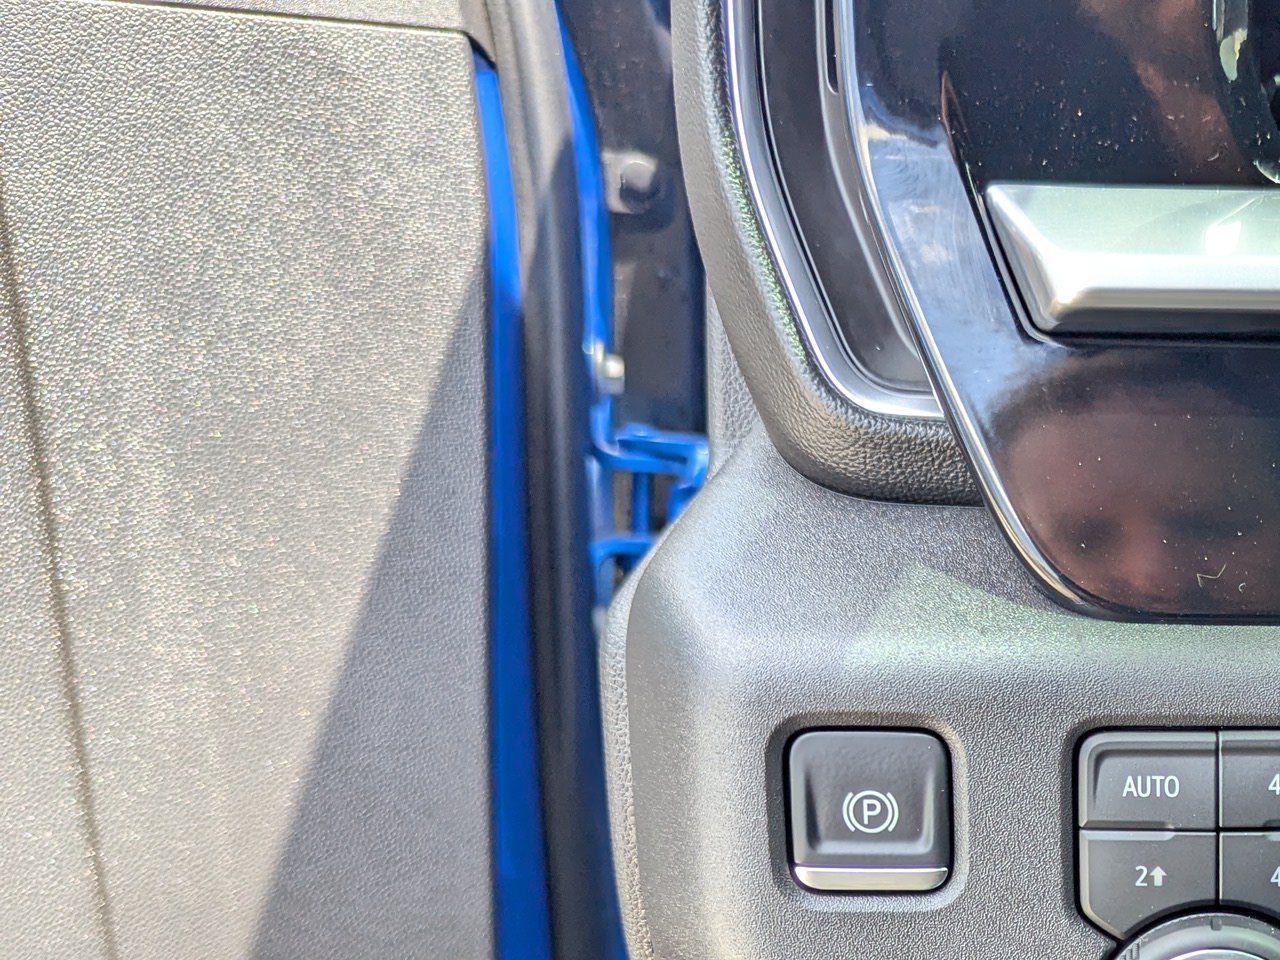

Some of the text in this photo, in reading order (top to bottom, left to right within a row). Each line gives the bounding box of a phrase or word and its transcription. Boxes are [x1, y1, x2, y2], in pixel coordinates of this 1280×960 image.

[1122, 775, 1180, 798] AUTO
[862, 799, 882, 825] P
[1135, 866, 1148, 887] 2
